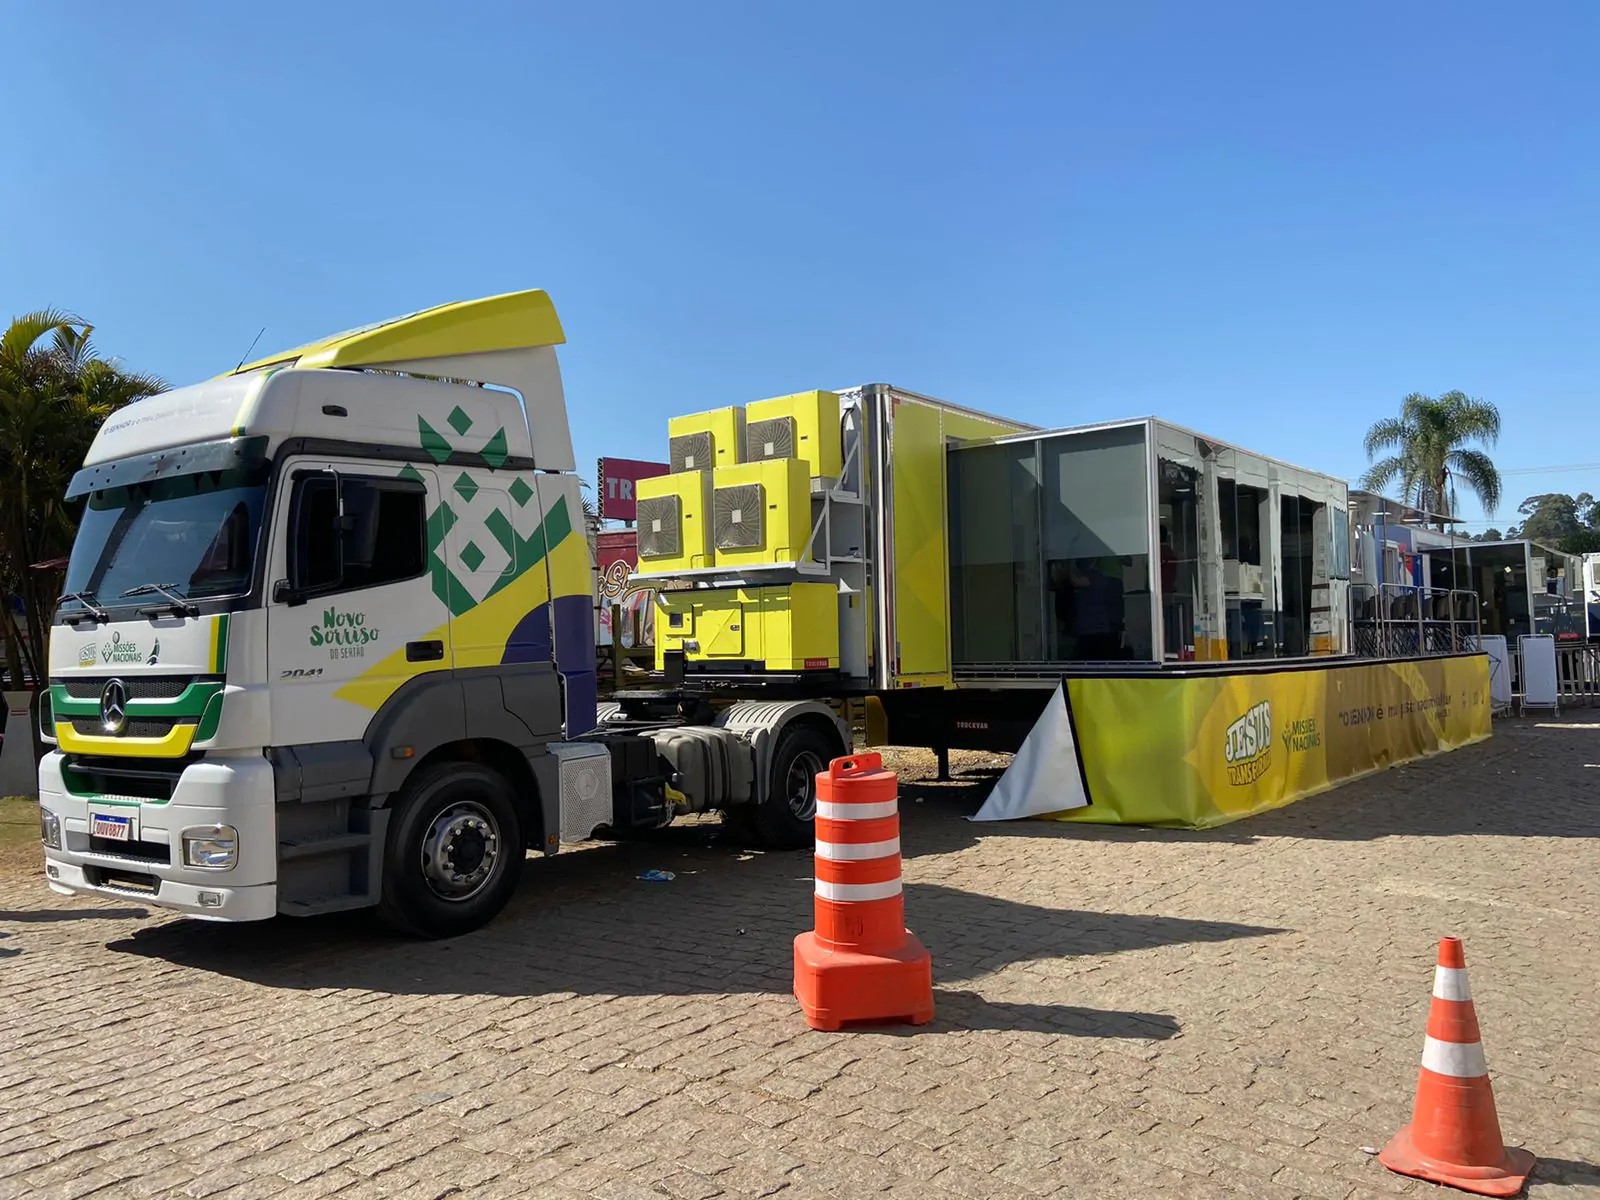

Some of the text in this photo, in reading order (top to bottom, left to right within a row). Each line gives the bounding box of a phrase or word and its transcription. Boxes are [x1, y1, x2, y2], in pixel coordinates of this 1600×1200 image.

[606, 477, 633, 501] TR
[323, 606, 366, 629] Novo
[309, 624, 380, 647] Sorriso
[330, 644, 365, 660] DO SERTÃO
[280, 668, 323, 679] 2041
[1376, 703, 1384, 720] é
[956, 720, 989, 730] TRUCKVAN
[1225, 699, 1271, 763] JESUS
